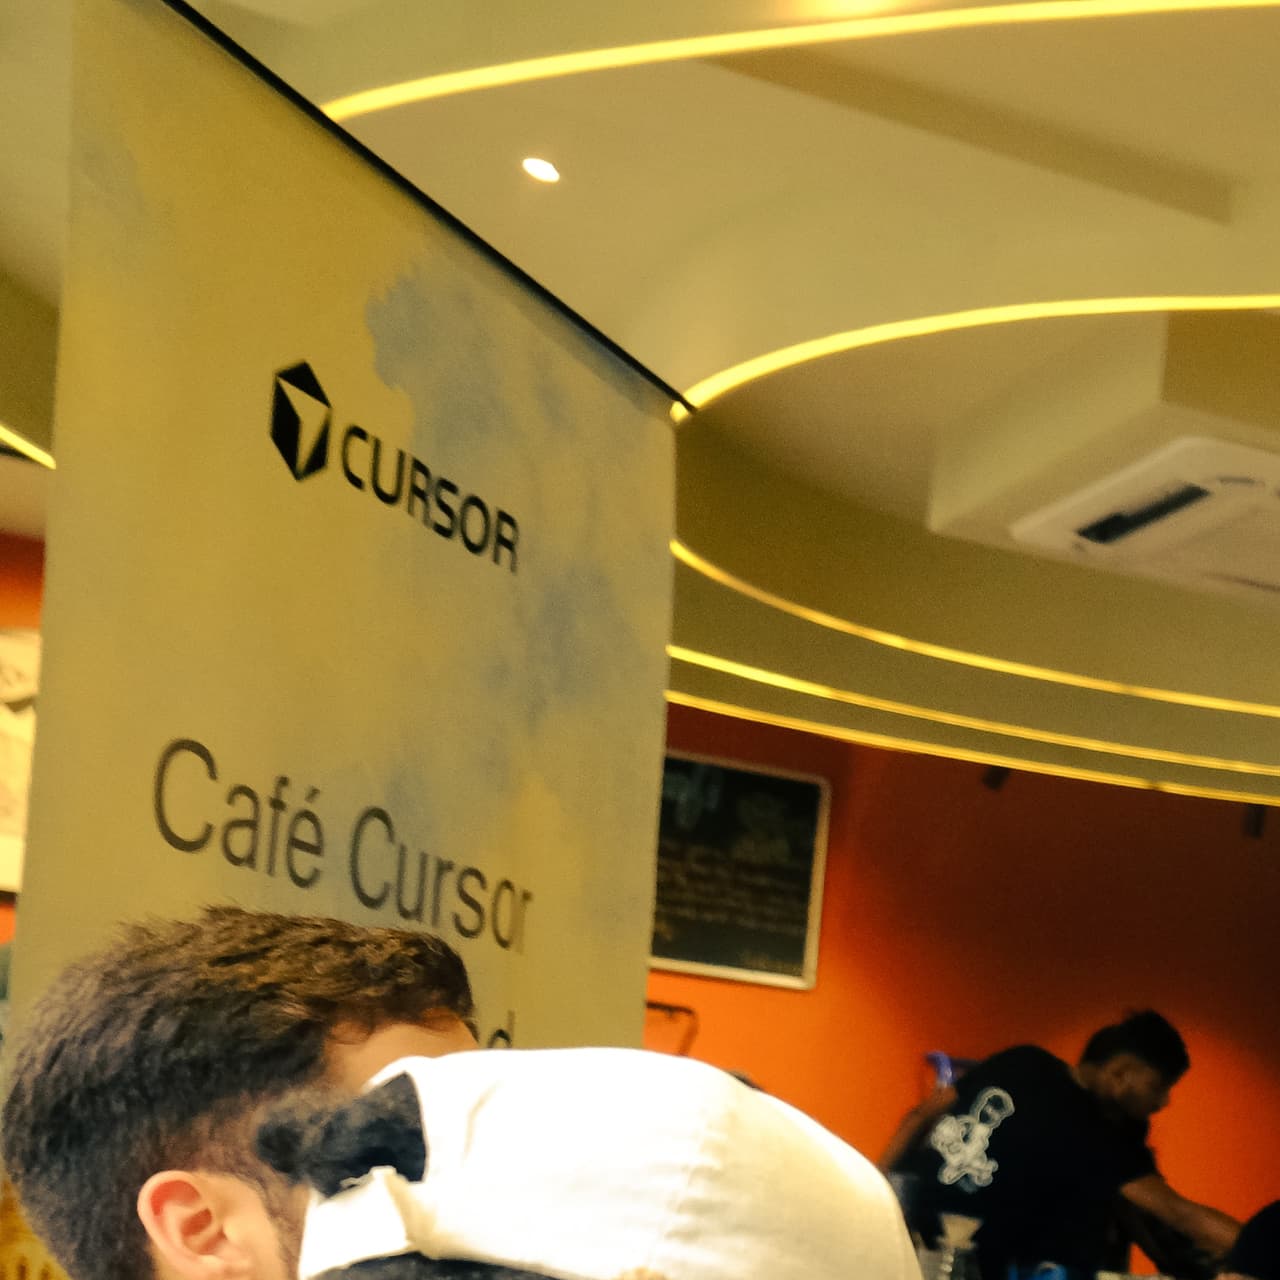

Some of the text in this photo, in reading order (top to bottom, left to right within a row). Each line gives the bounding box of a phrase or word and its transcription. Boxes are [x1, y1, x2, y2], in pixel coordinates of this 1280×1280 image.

[342, 424, 518, 573] CURSOR
[154, 738, 324, 889] Café
[350, 806, 534, 954] Cursor
